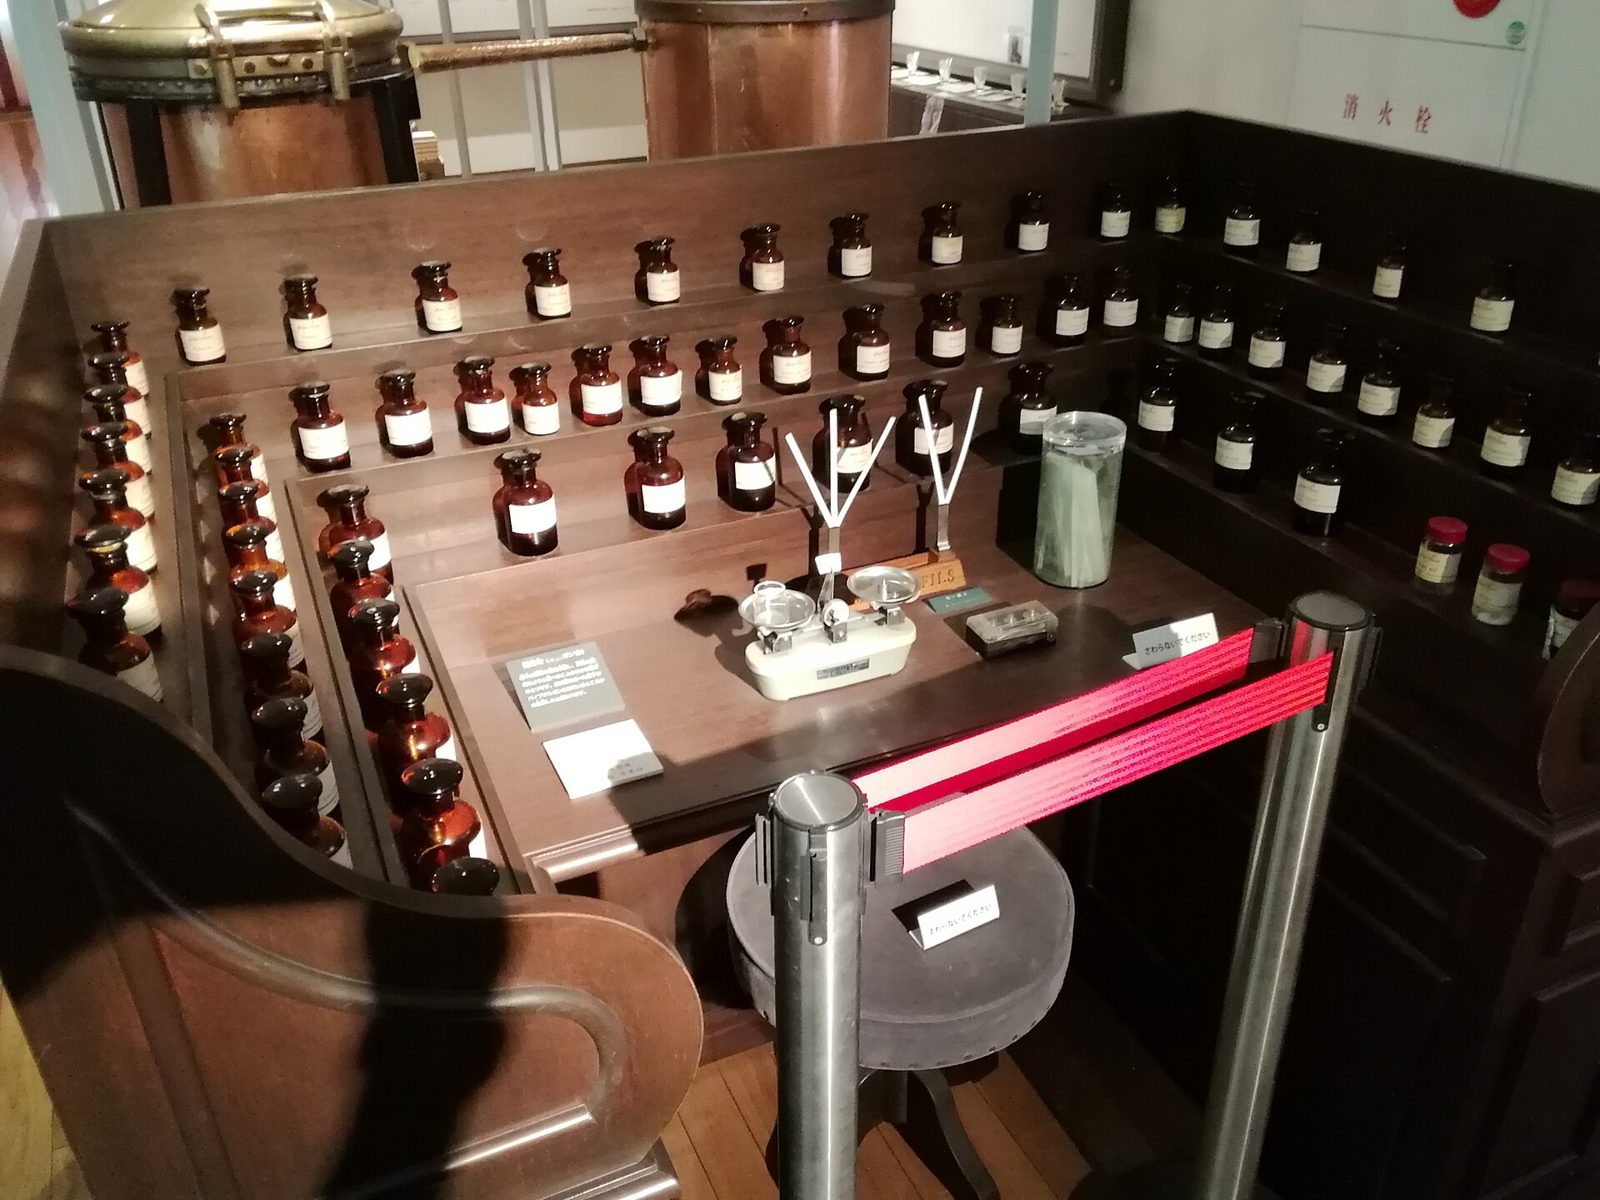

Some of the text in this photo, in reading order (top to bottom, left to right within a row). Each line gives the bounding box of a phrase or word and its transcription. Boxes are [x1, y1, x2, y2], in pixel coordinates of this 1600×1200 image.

[1343, 93, 1432, 134] 消火栓
[1144, 631, 1211, 656] さわらないでください
